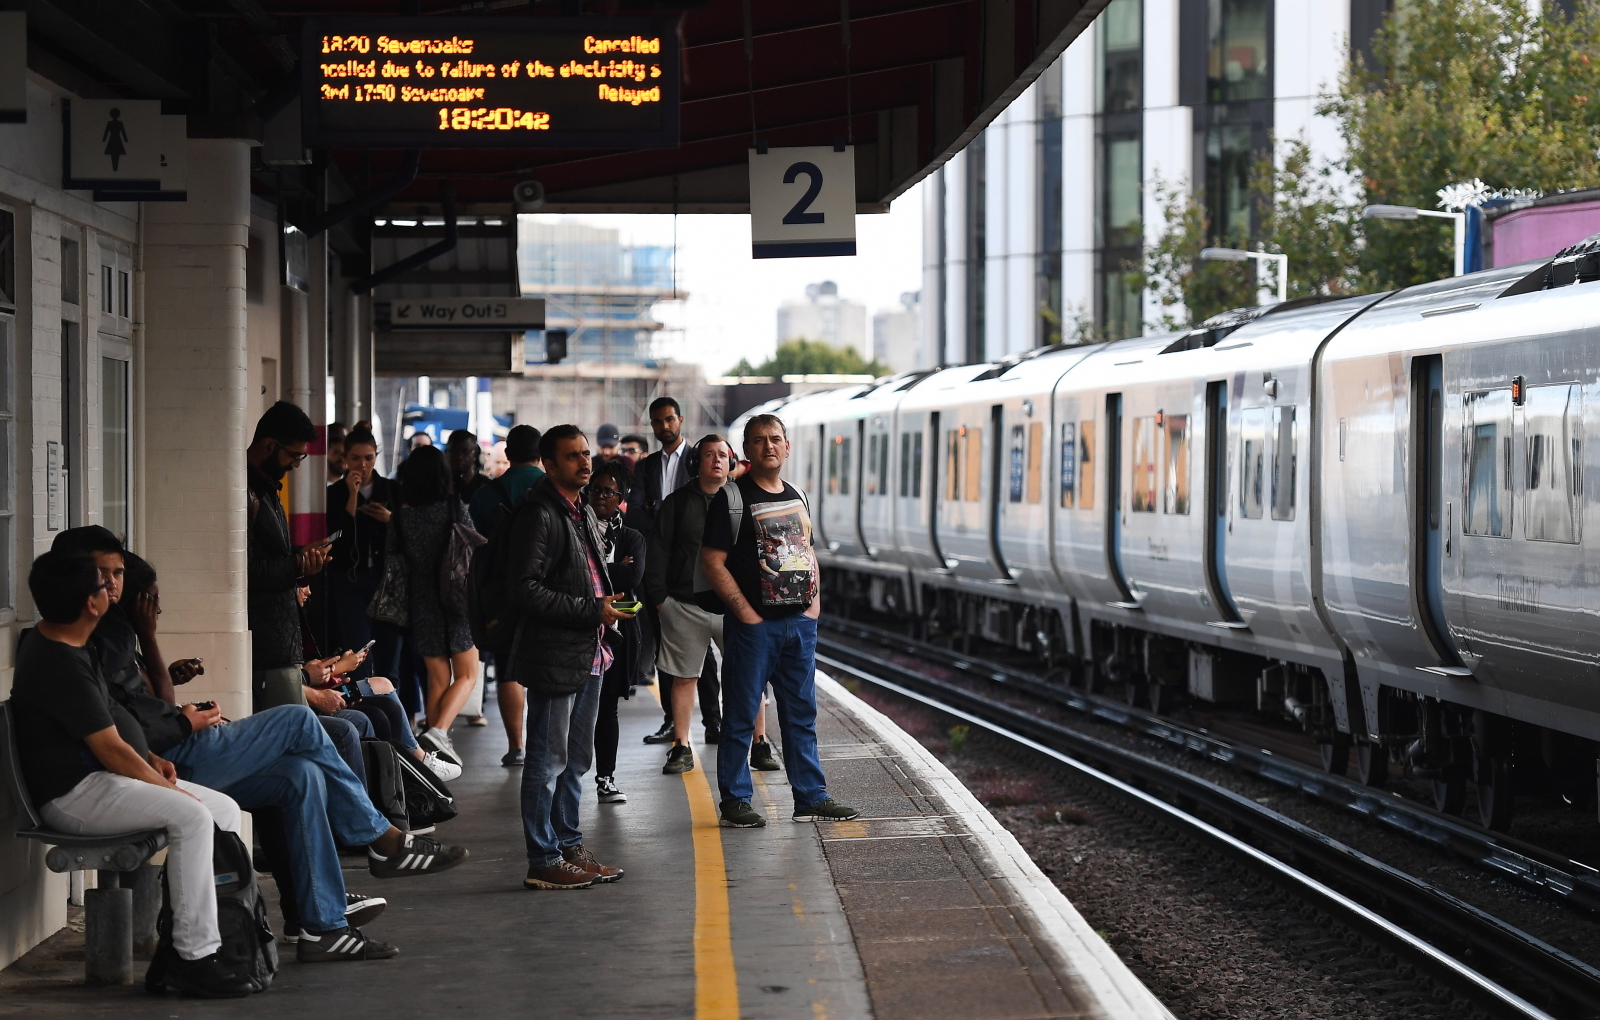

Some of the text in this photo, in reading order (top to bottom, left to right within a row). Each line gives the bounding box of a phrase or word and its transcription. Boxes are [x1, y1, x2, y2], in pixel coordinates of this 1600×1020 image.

[321, 35, 660, 55] 18:20 Sevenoaks Cancelled
[381, 60, 410, 78] due
[414, 60, 435, 78] to
[440, 60, 496, 79] failure
[500, 60, 521, 78] of
[525, 60, 555, 78] the
[559, 60, 646, 82] electricity
[650, 65, 662, 79] s
[320, 83, 661, 107] 3rd 17:50 Sevenoaks Delayed
[438, 107, 550, 131] 18:20:42
[782, 161, 825, 225] 2
[420, 304, 492, 321] Way Out
